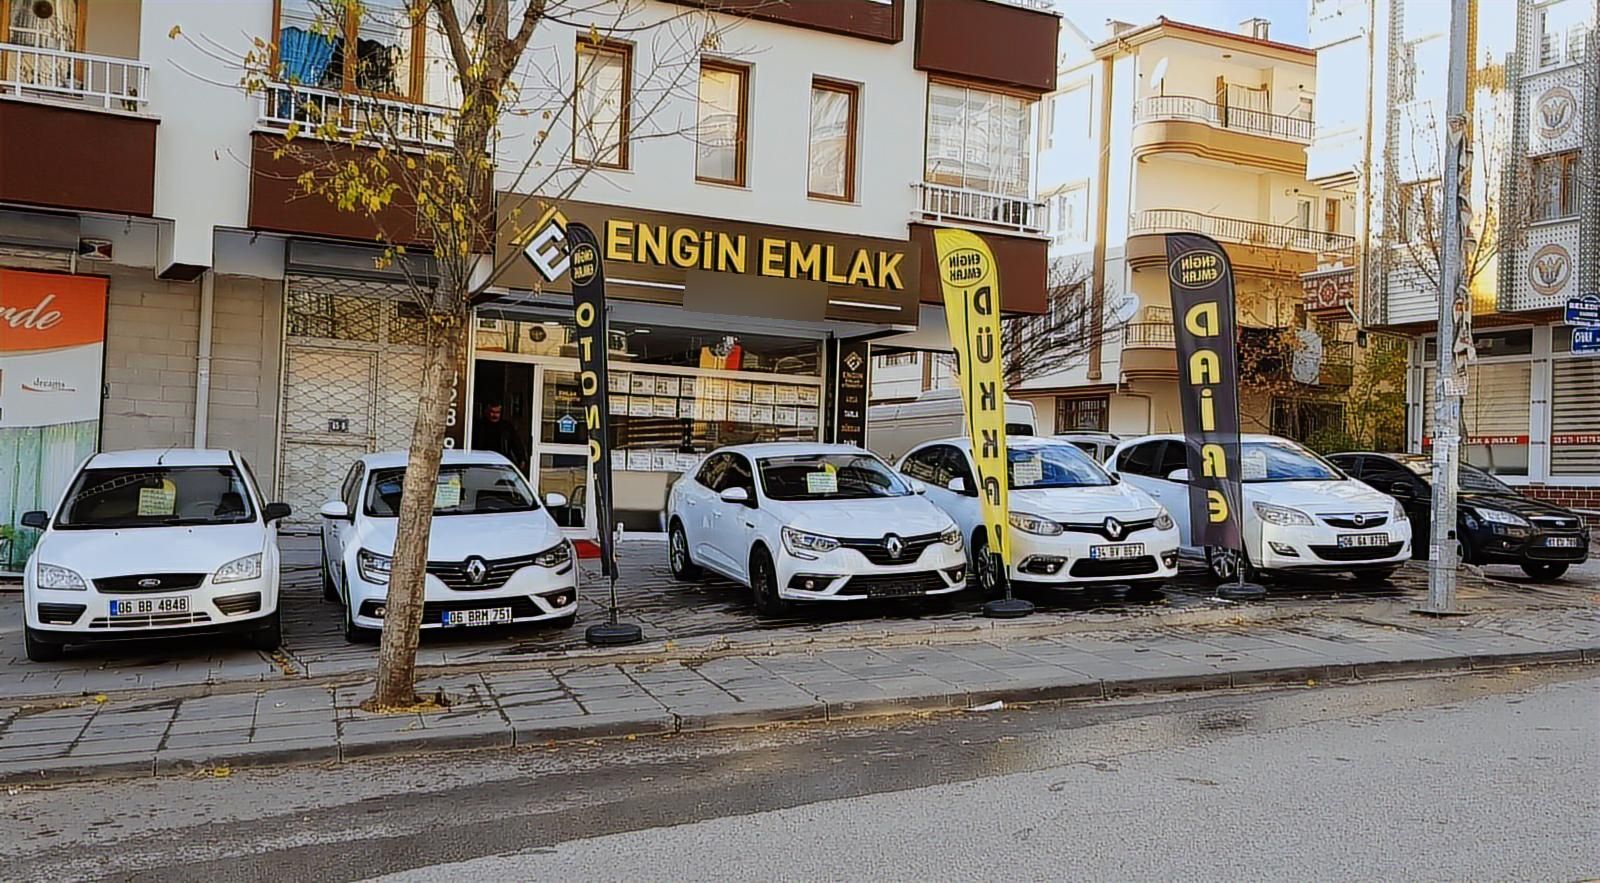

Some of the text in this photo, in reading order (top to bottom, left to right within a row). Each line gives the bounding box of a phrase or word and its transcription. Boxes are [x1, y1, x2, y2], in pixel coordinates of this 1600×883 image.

[761, 237, 905, 290] EMLAK
[118, 601, 132, 613] 06
[158, 598, 187, 611] 4848
[450, 611, 464, 623] 06
